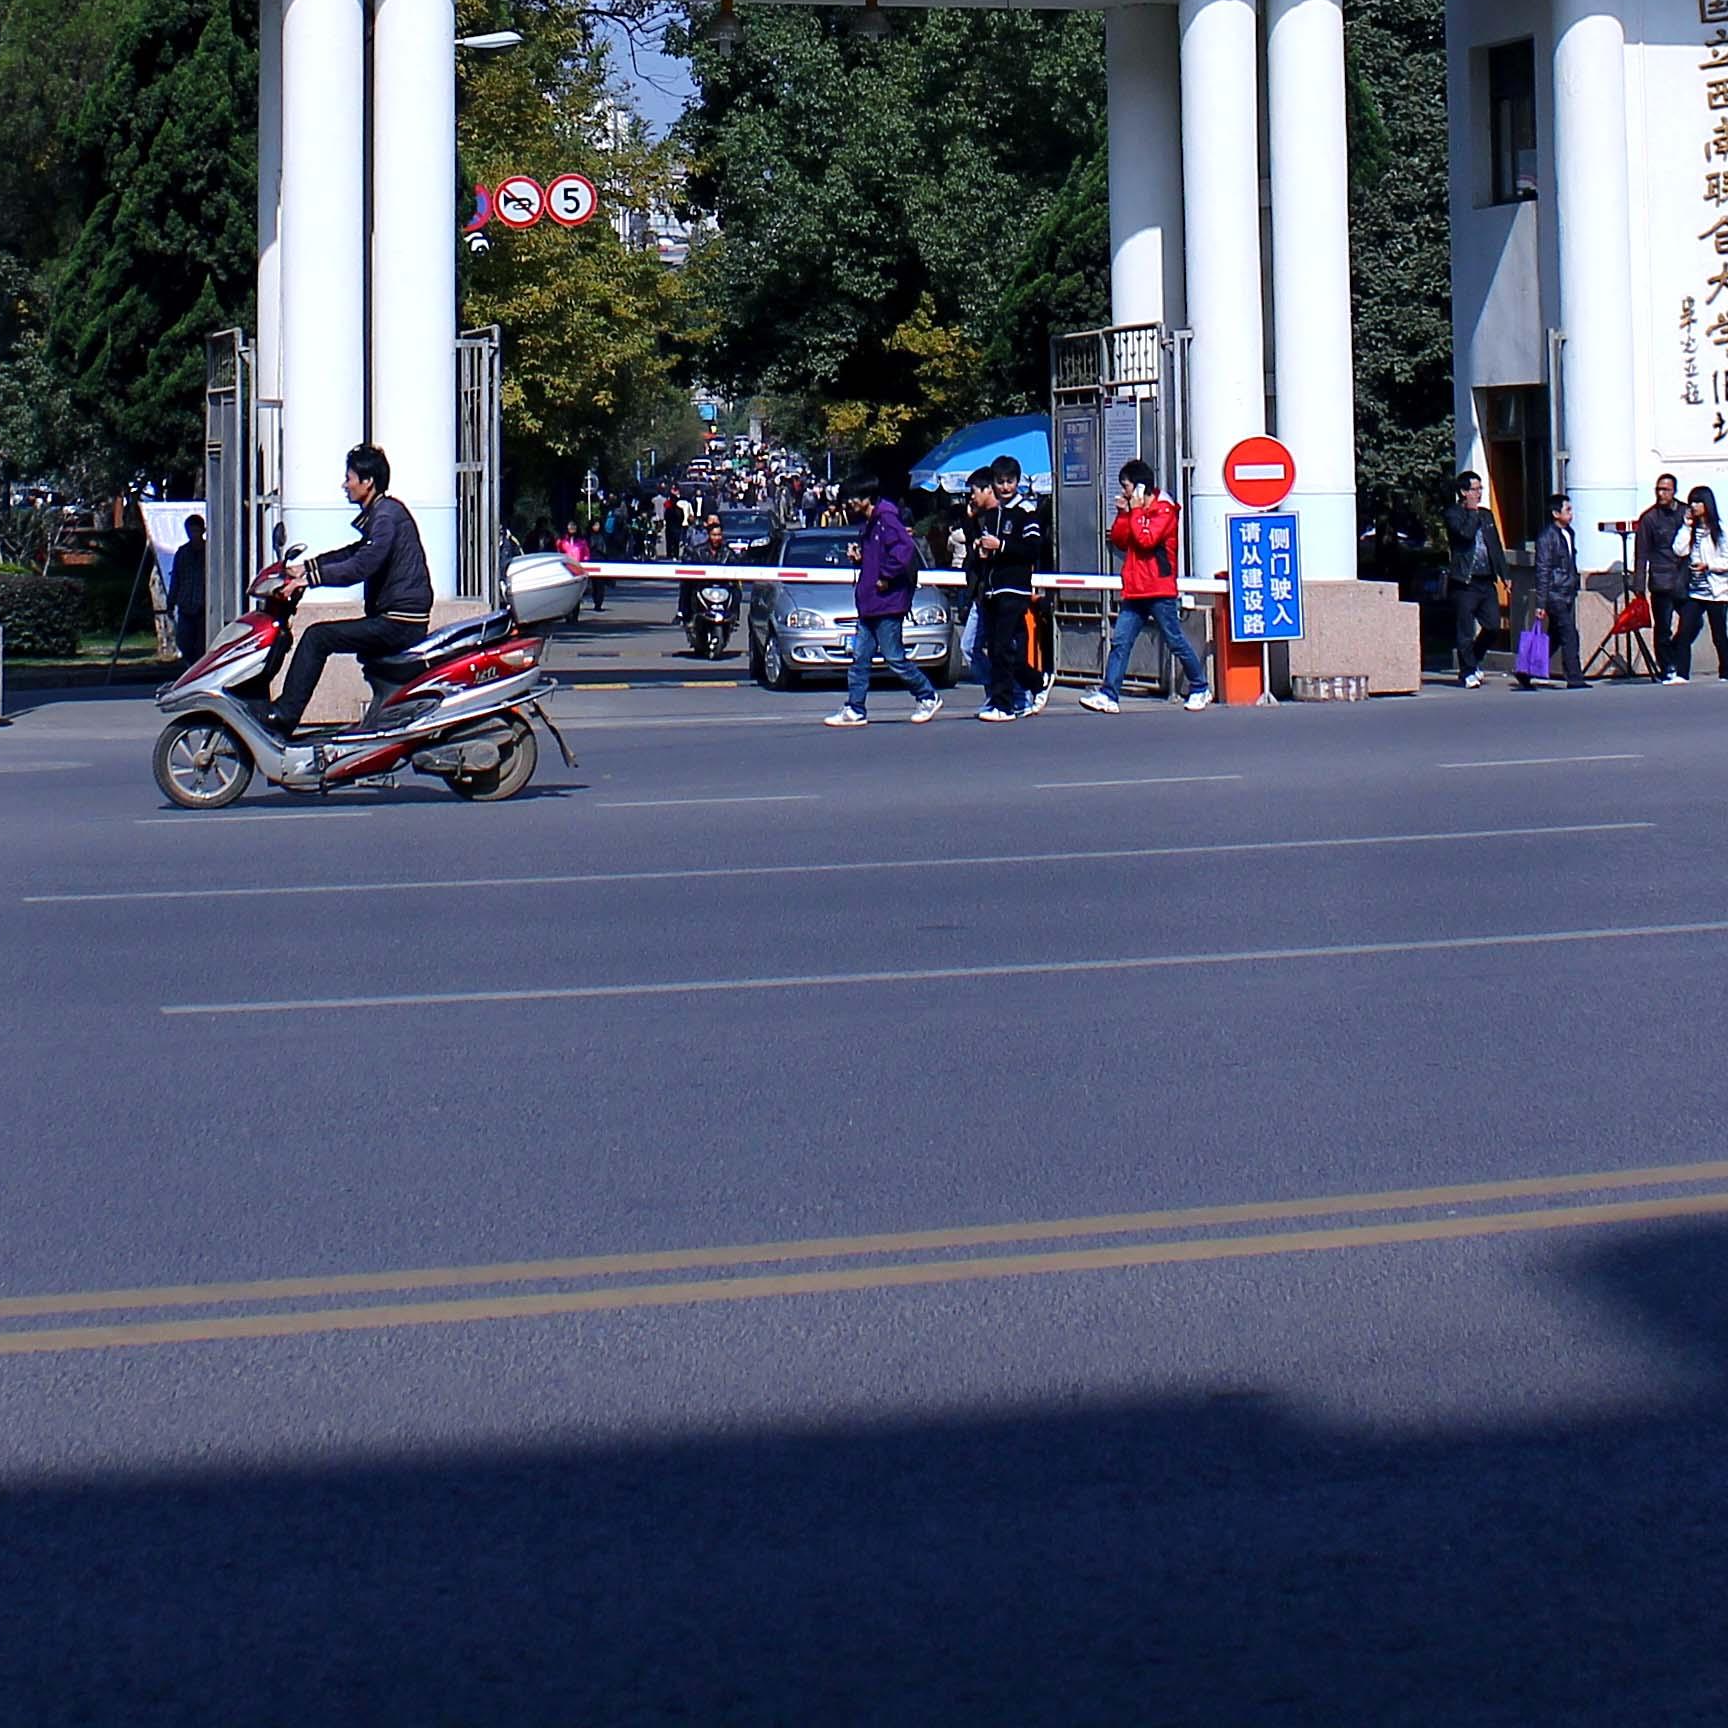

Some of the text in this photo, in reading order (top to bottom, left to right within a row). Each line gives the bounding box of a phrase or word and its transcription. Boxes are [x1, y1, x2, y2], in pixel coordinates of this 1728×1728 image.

[563, 188, 580, 213] 5
[1240, 522, 1265, 635] 请从建设路
[1269, 528, 1293, 625] 侧门驶入
